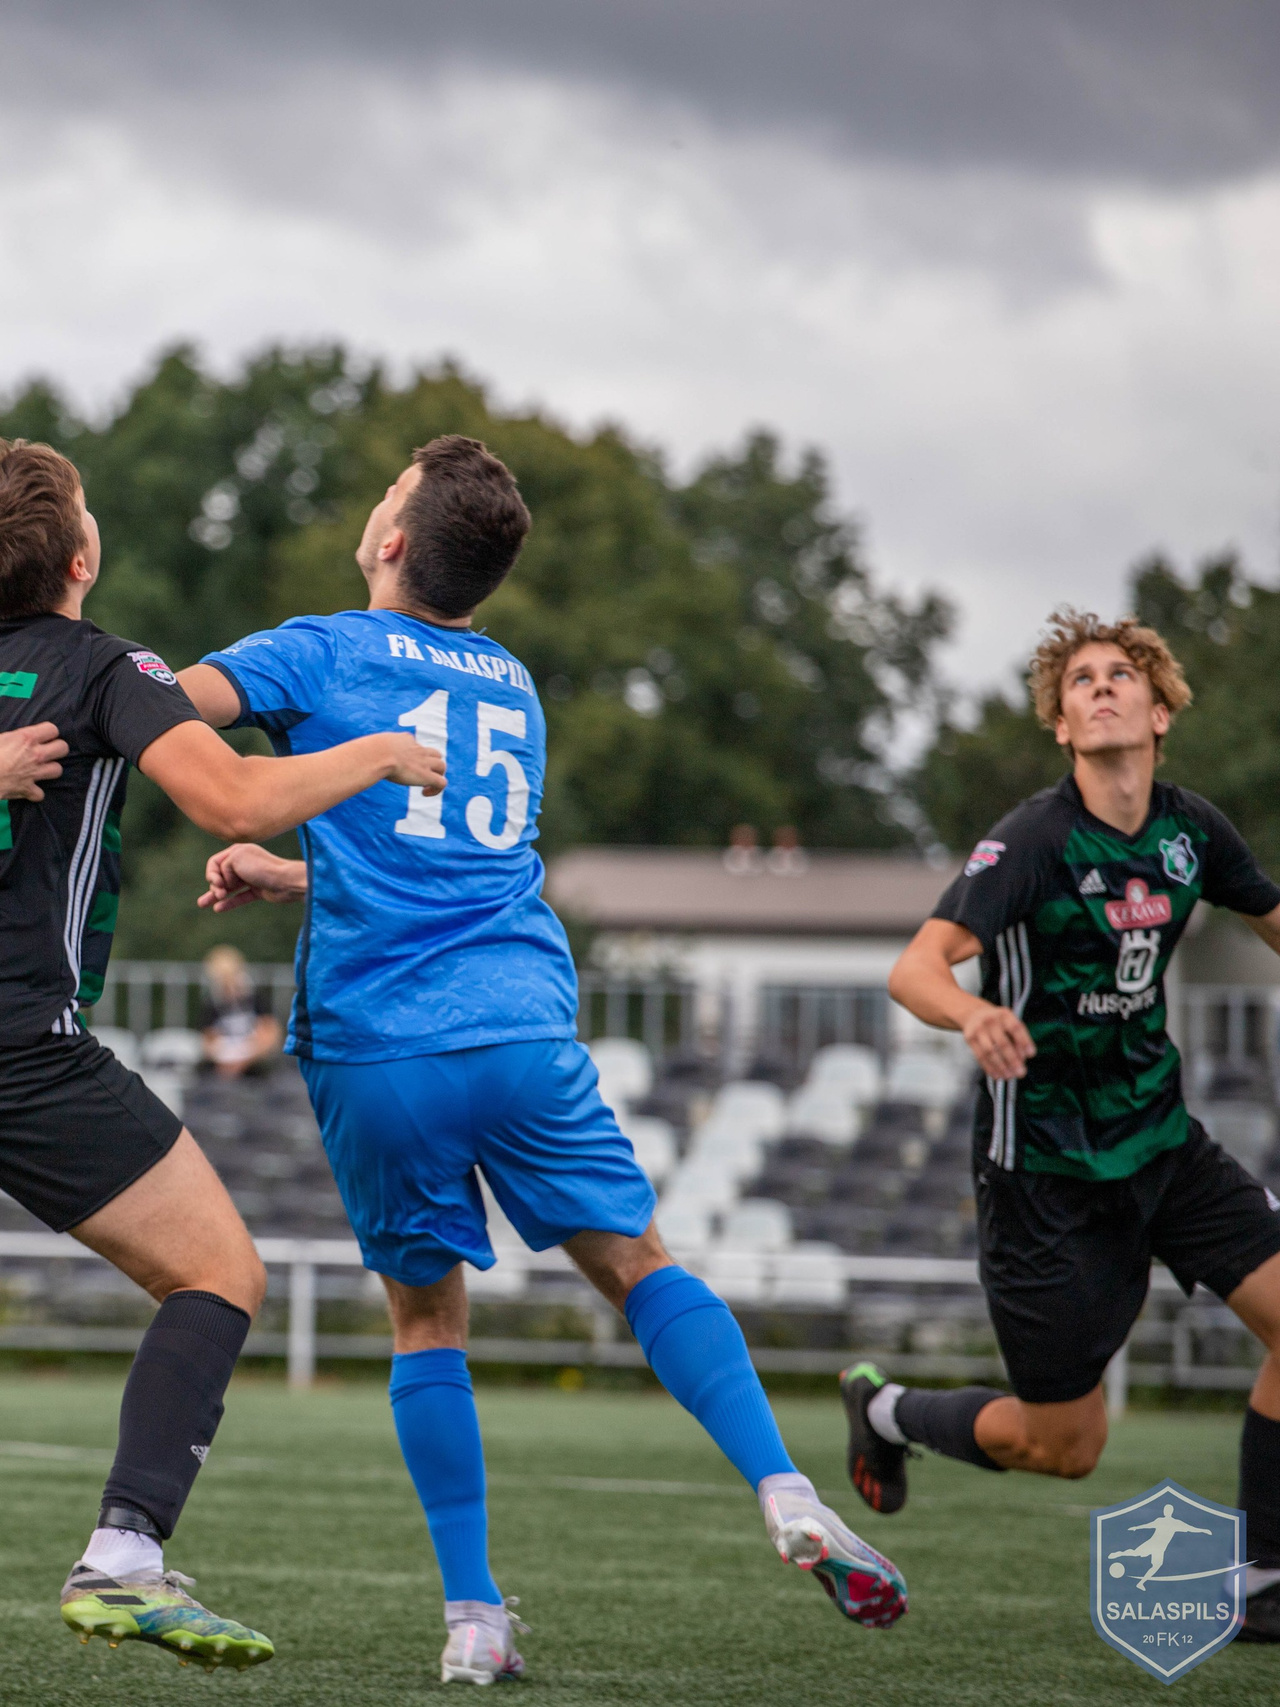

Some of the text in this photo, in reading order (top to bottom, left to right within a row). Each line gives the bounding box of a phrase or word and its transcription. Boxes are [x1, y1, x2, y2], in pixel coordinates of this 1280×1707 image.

[386, 633, 534, 697] FK SALASPIL
[394, 689, 531, 850] 15
